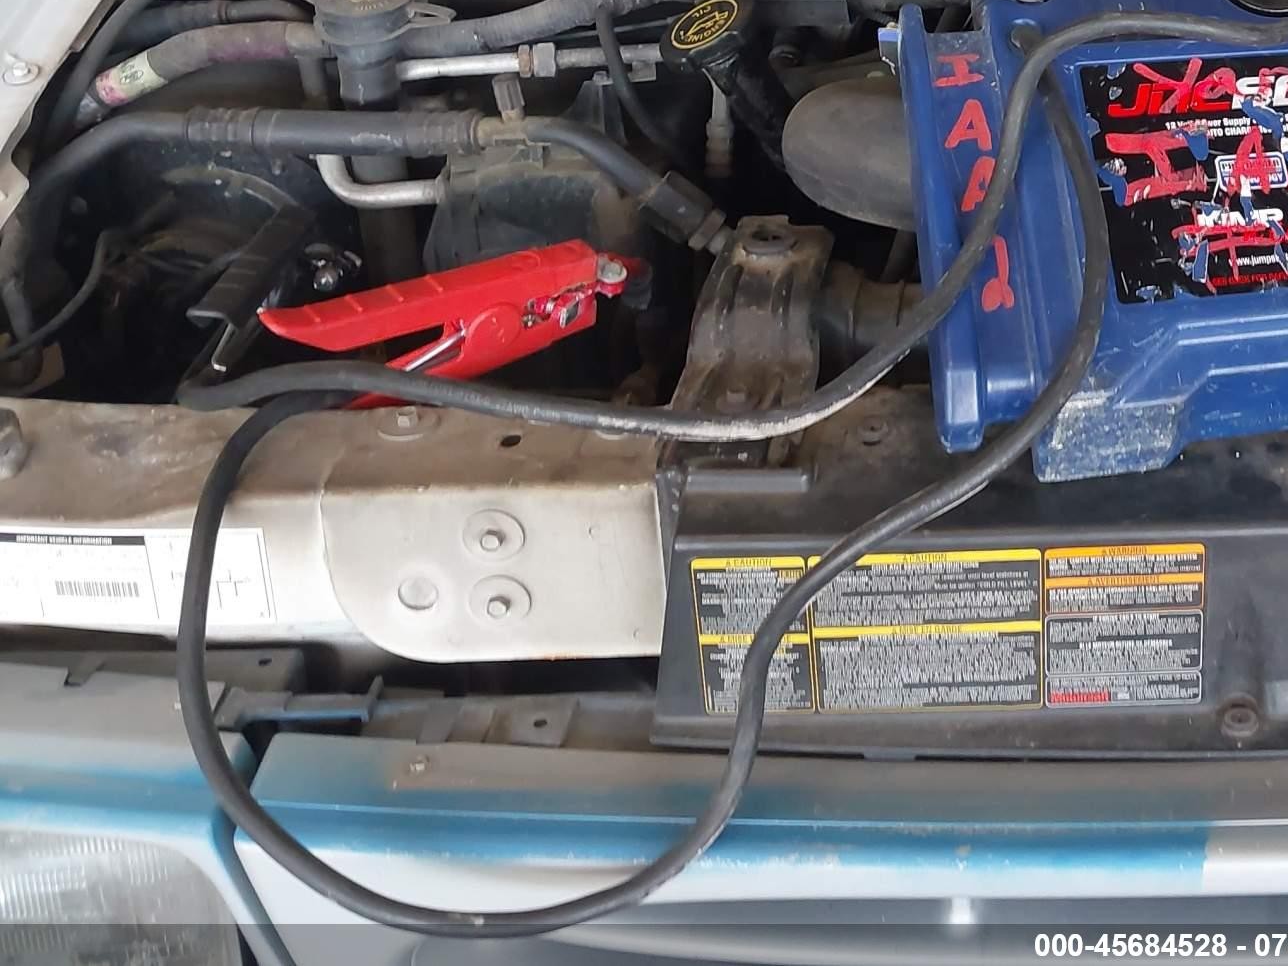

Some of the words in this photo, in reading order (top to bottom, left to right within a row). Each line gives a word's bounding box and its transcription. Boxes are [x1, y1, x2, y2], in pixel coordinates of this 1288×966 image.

[1223, 116, 1251, 127] Supply
[1109, 545, 1148, 556] WARNING
[733, 558, 772, 568] CAUTION
[909, 553, 948, 563] CAUTION
